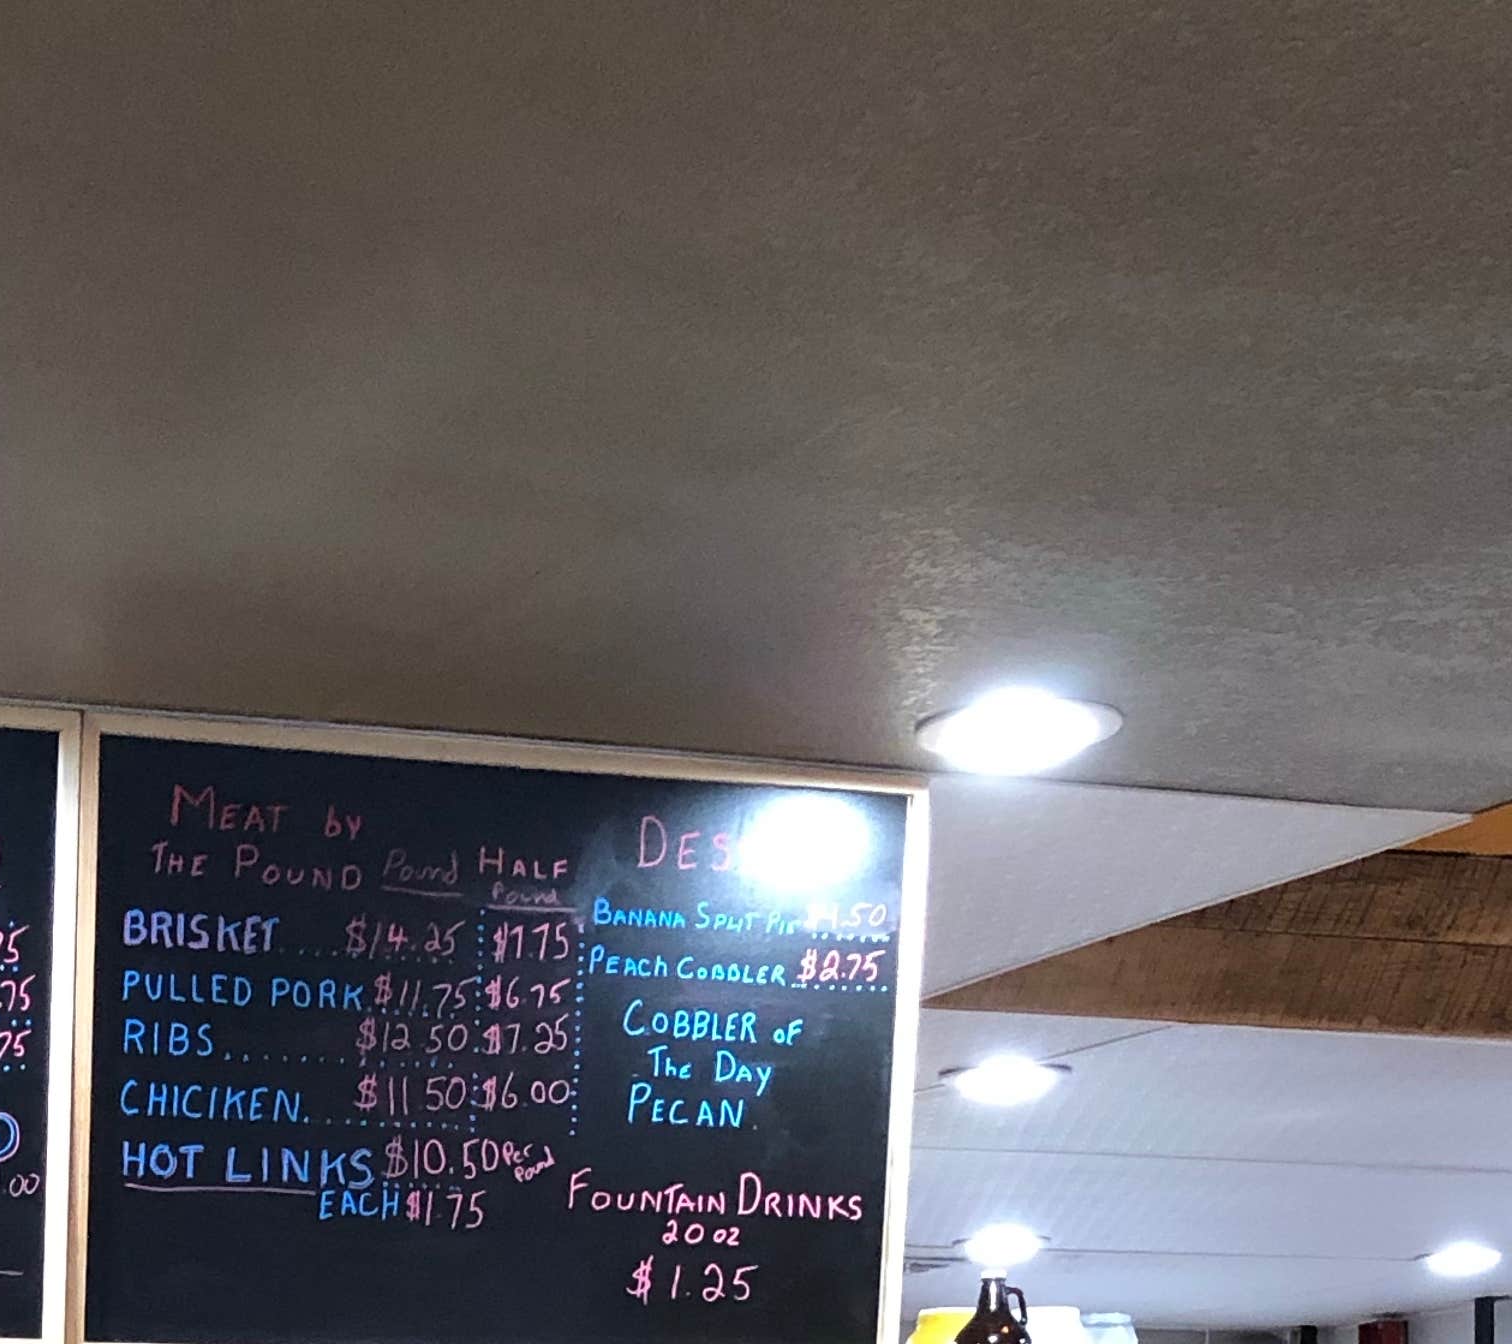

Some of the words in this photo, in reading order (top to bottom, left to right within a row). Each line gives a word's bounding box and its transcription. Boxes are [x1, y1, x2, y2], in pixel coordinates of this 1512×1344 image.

[169, 784, 288, 833] MEAT
[151, 841, 208, 877] THE
[235, 844, 363, 891] POUND
[478, 845, 568, 880] HALF
[123, 909, 280, 955] BRISKET
[345, 913, 466, 960] $14.25
[593, 896, 686, 929] BANANA
[695, 901, 759, 933] SPLIT
[677, 956, 786, 987] COBBLER
[797, 949, 886, 984] $2.75
[122, 970, 252, 1007] PULLED
[271, 977, 364, 1010] PORK
[374, 971, 478, 1019] $11.75
[123, 1018, 214, 1057] RIBS
[482, 1013, 570, 1055] $7.25
[622, 998, 757, 1043] COBBLER
[628, 1082, 743, 1128] PECAN
[122, 1140, 205, 1179] HOT
[225, 1148, 375, 1190] LINKS
[381, 1137, 499, 1180] $10.50
[319, 1190, 399, 1222] EACH
[406, 1191, 486, 1229] $1.75
[568, 1168, 725, 1215] FOUNTAIN
[737, 1172, 862, 1220] DRINKS
[626, 1255, 759, 1305] $1.25
